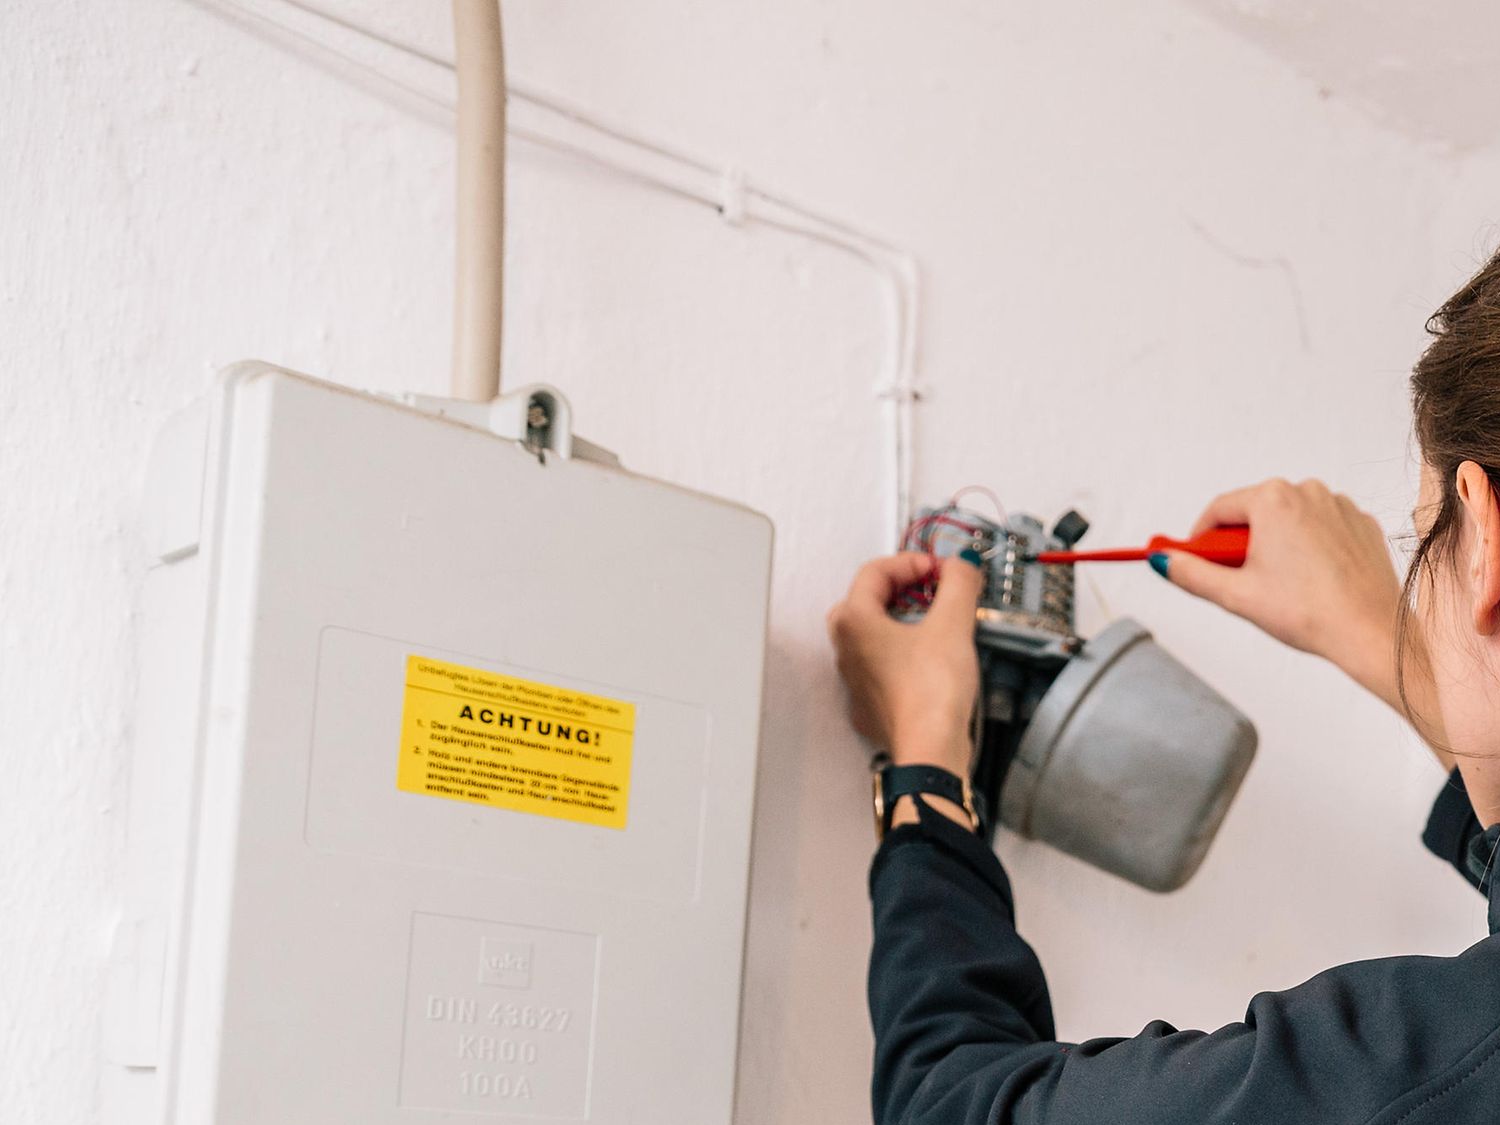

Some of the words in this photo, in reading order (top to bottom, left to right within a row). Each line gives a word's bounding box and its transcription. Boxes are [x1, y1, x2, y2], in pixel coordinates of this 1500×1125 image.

[459, 705, 600, 746] ACHTUNG!
[426, 994, 477, 1025] DIN
[488, 1002, 574, 1033] 43627
[460, 1071, 534, 1100] 100A
